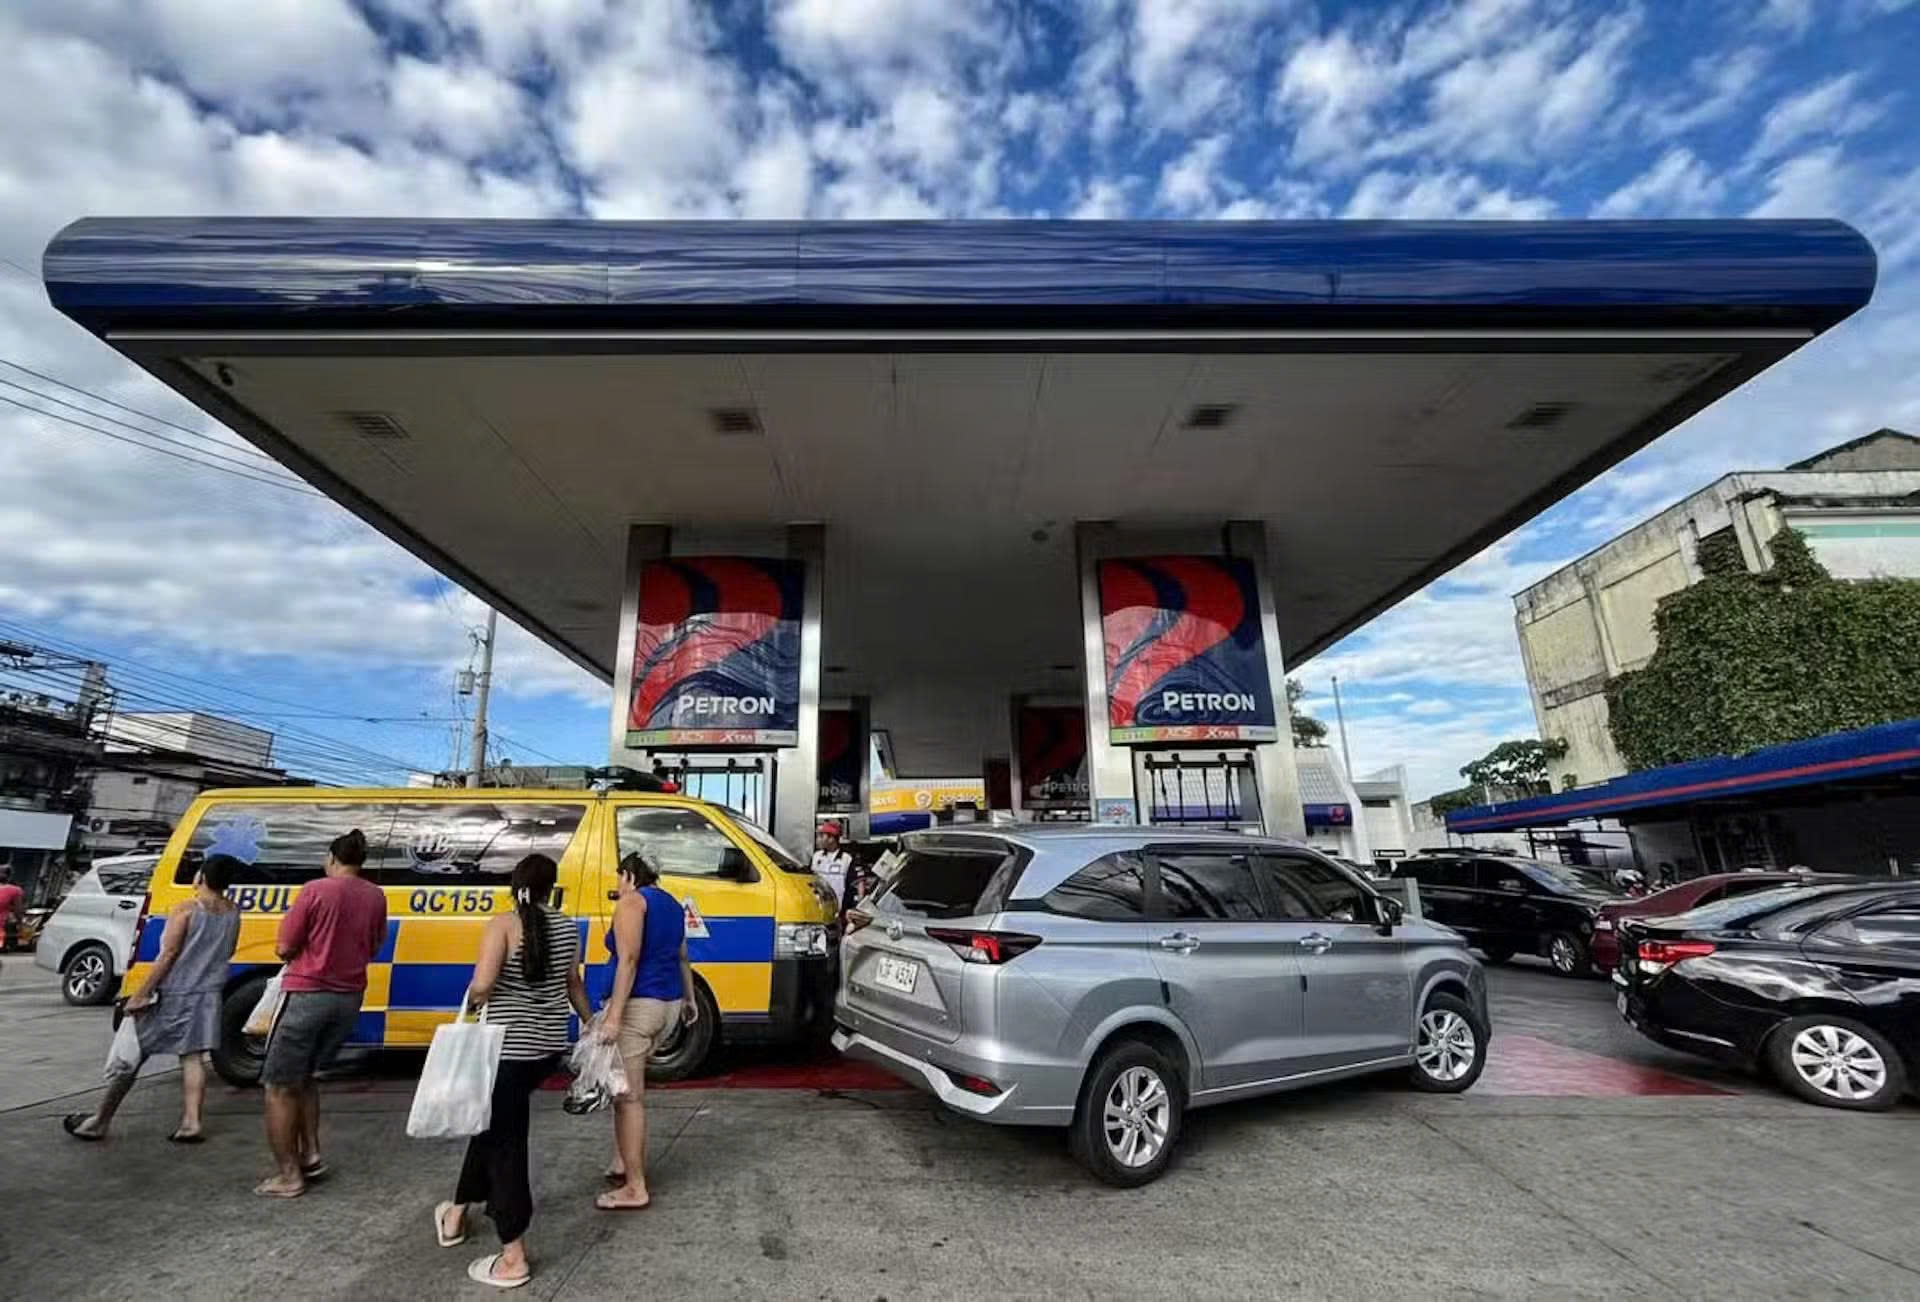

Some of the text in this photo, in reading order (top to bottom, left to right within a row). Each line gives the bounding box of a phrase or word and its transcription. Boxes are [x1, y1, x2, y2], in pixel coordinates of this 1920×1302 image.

[678, 695, 775, 714] PETRON
[1163, 691, 1256, 712] PETRON
[410, 889, 495, 913] QC155
